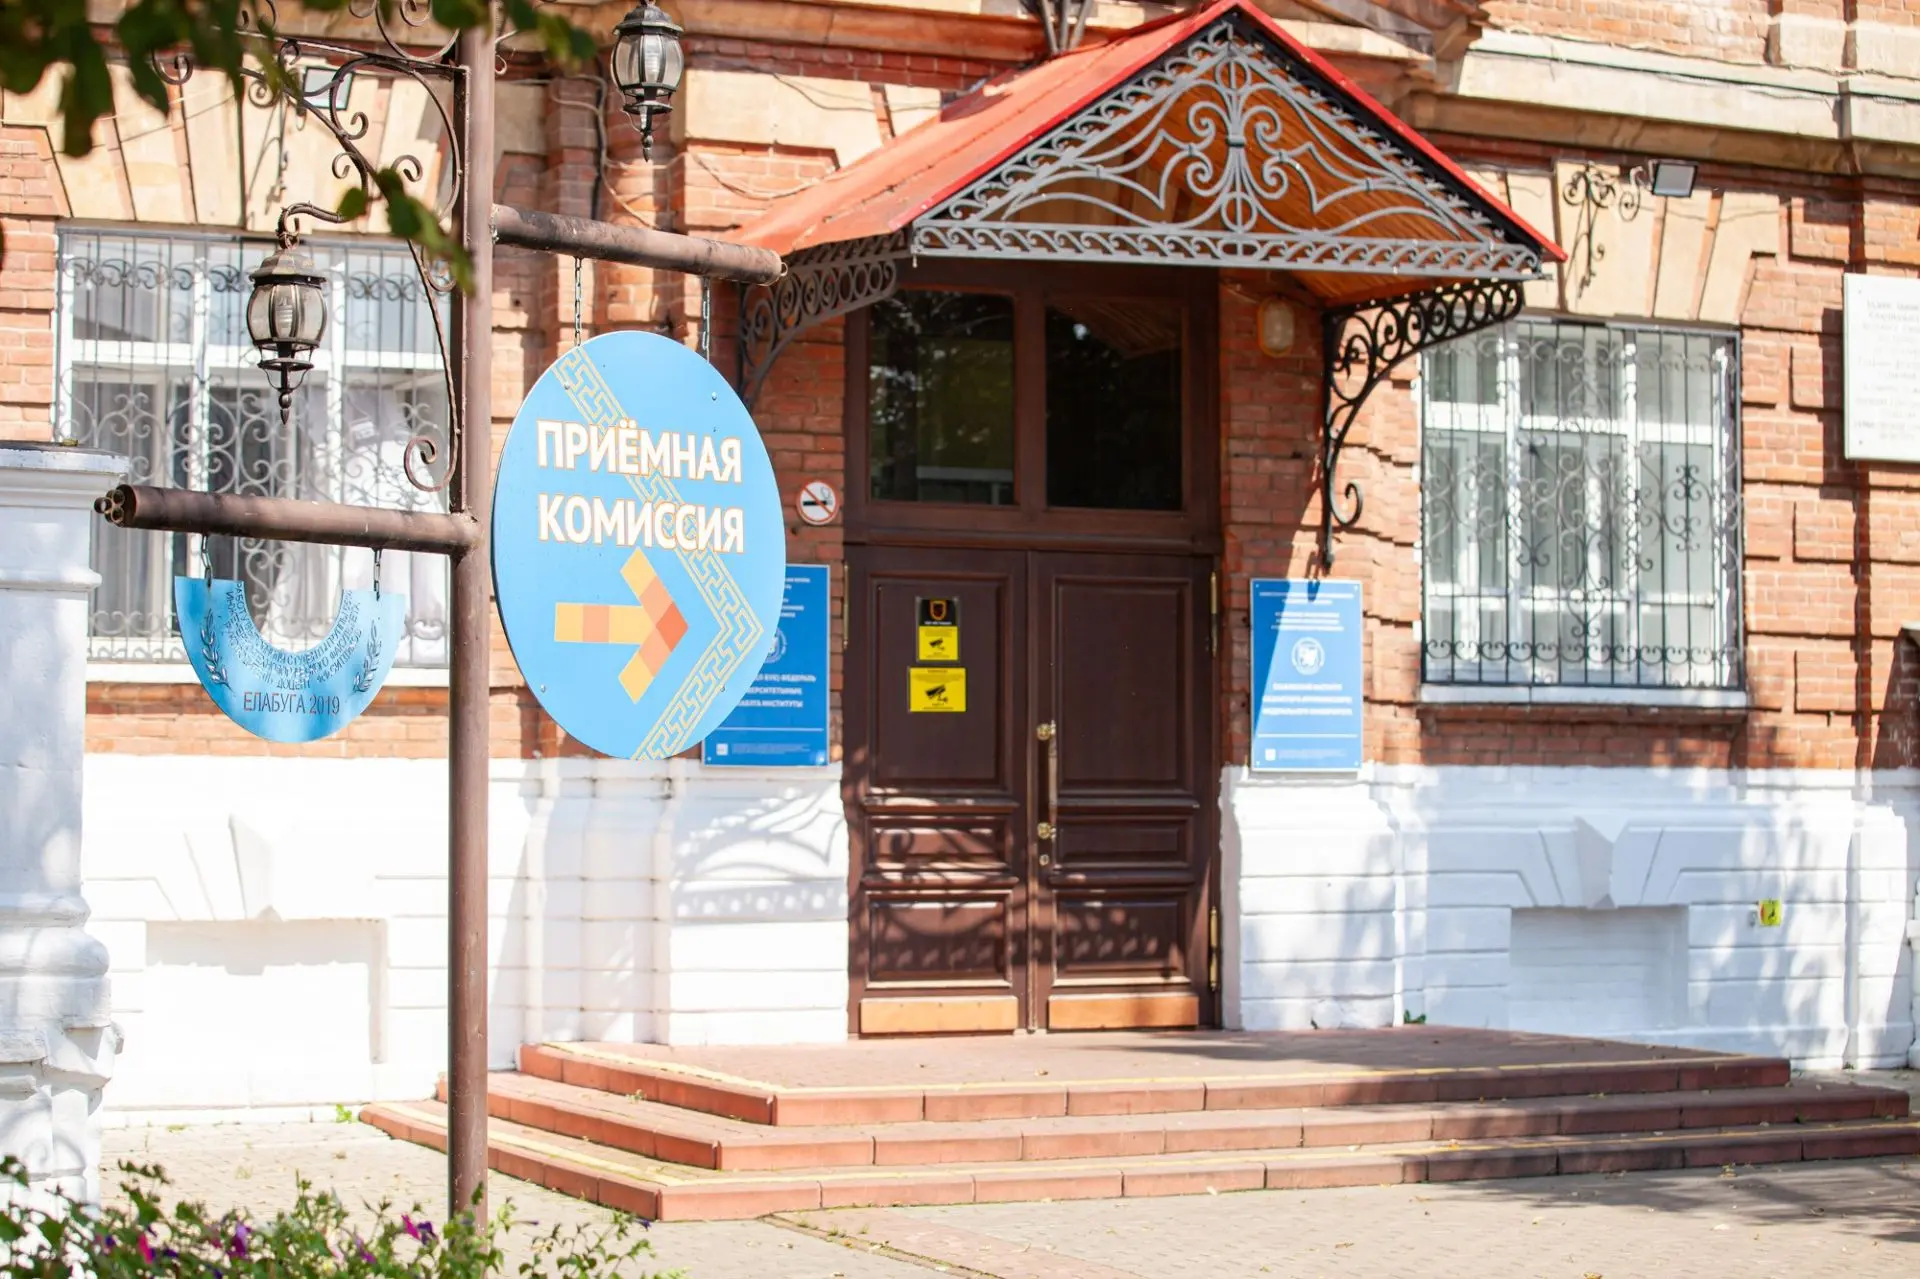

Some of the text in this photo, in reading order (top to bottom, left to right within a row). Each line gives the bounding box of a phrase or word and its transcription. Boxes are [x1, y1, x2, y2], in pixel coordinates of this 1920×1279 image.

[536, 417, 743, 484] ПРИЁМНАЯ
[537, 493, 745, 554] КОМИССИЯ
[243, 691, 340, 715] ЕЛАБУГА 2019
